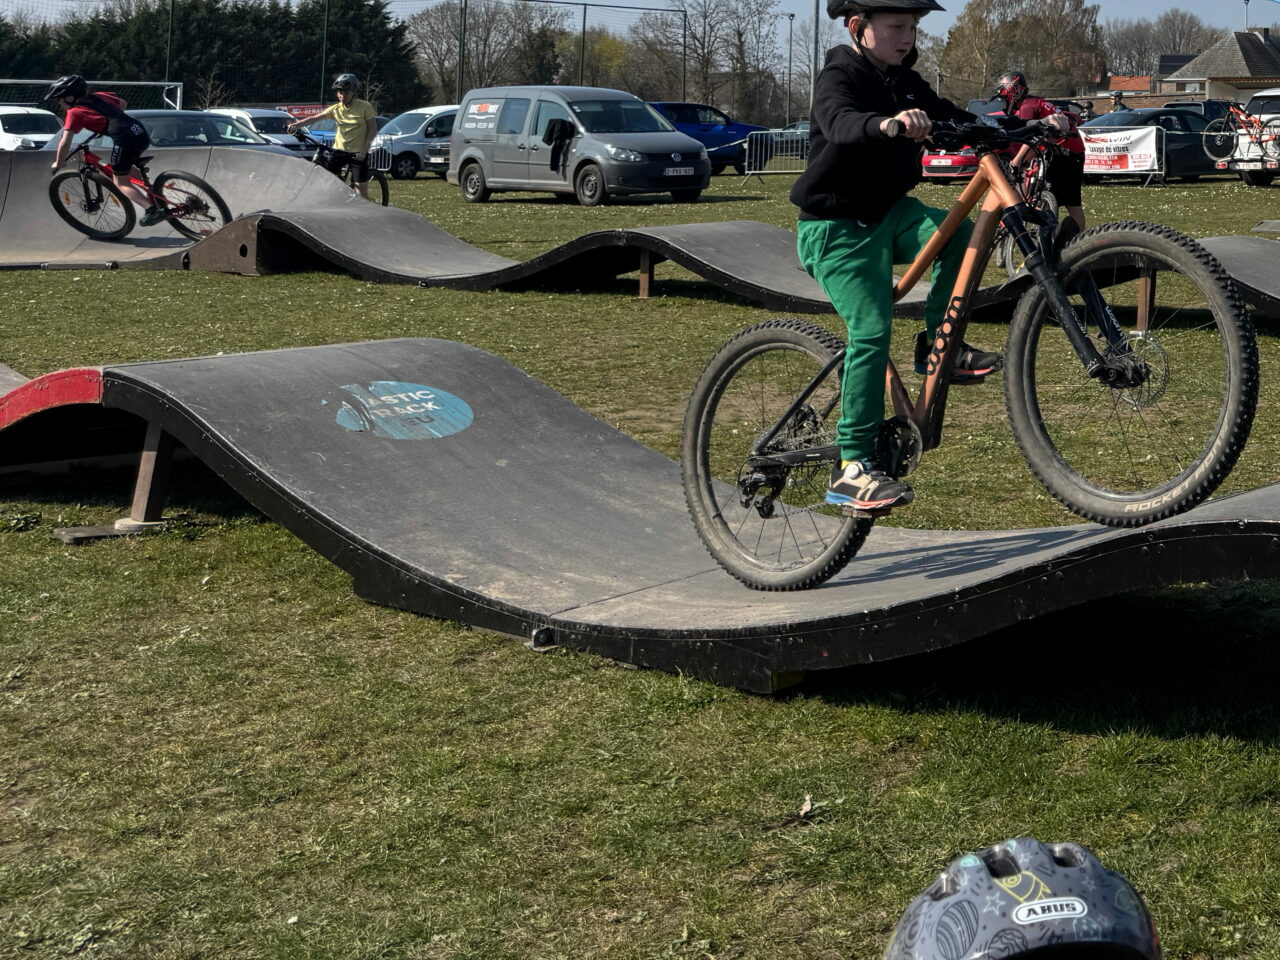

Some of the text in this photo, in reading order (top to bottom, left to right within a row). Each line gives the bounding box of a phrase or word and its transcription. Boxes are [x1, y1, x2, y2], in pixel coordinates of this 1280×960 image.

[927, 296, 964, 375] woom
[1124, 482, 1189, 513] ROCKET
[1025, 902, 1078, 919] ABUS
